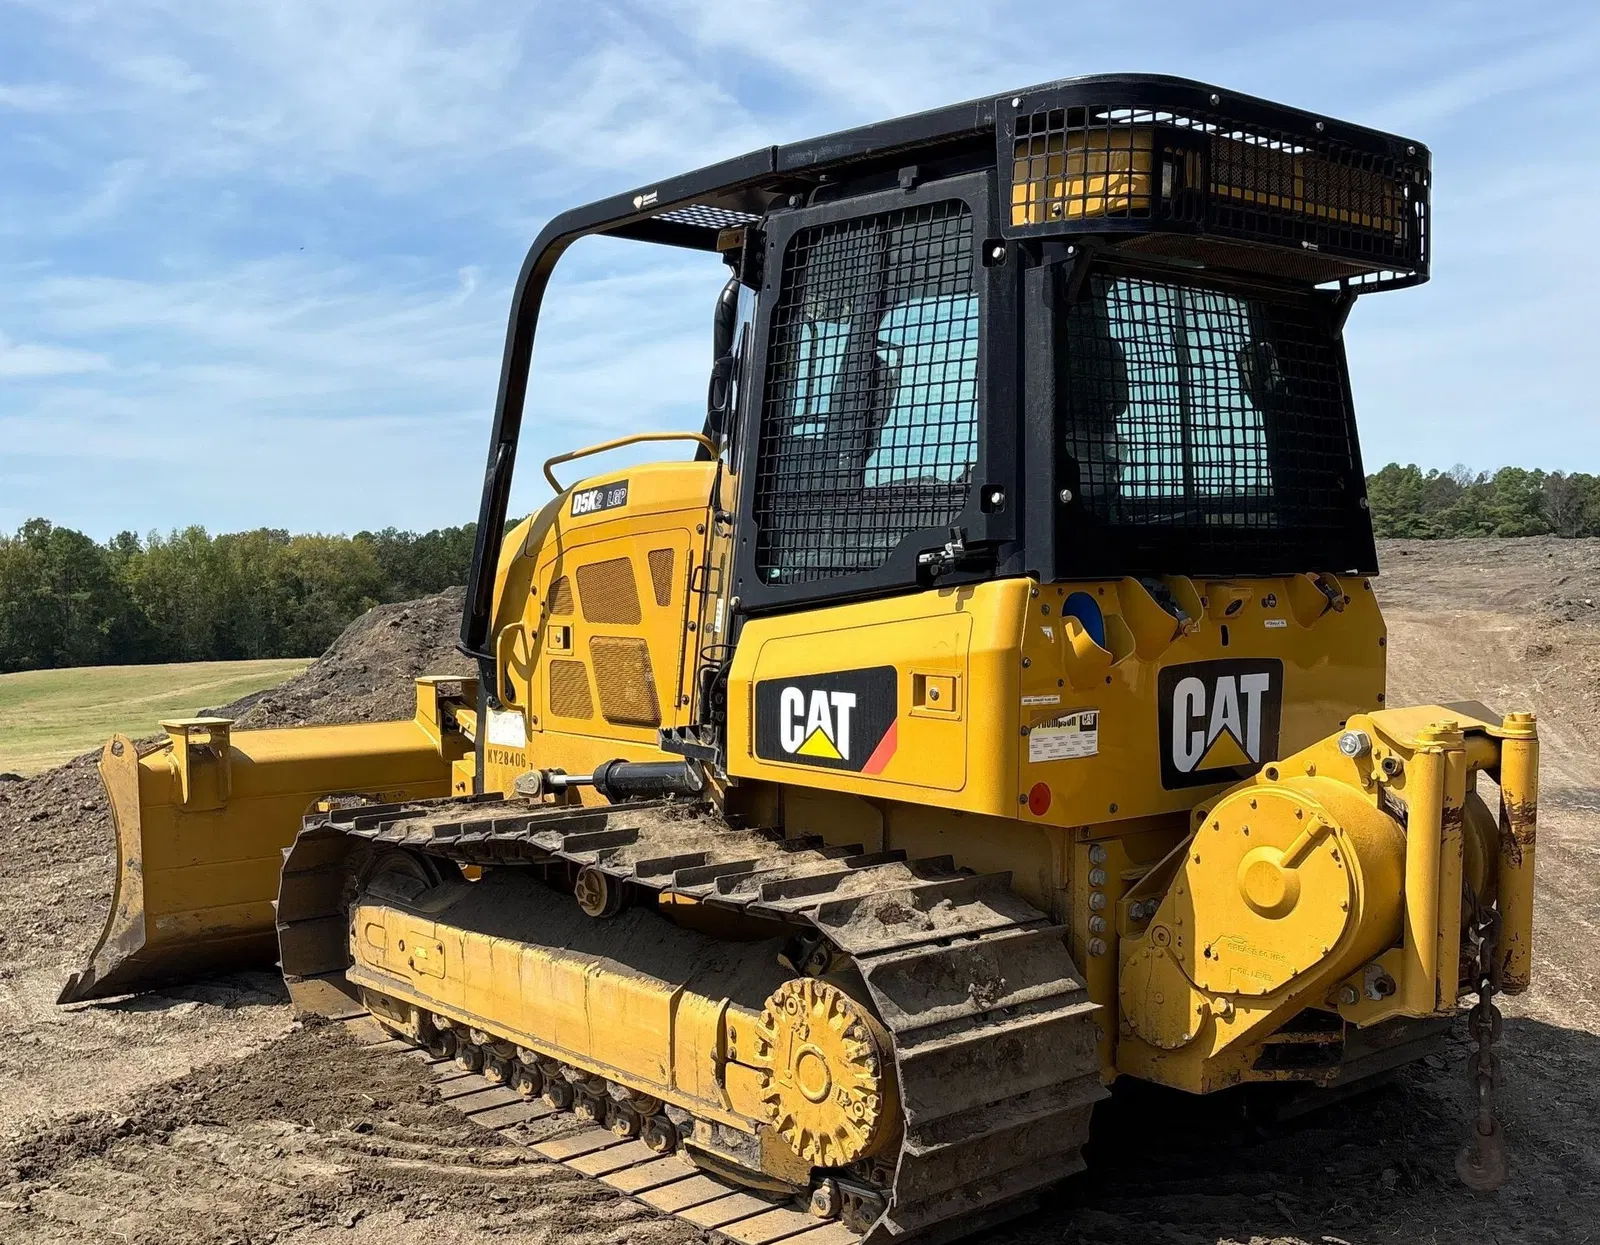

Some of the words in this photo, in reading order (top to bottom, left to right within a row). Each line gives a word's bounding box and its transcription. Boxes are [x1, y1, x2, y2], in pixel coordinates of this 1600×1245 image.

[572, 489, 604, 515] D5K2
[606, 487, 627, 507] LGP
[780, 686, 857, 761] CAT
[1081, 713, 1096, 726] CAT
[1172, 672, 1270, 773] CAT
[487, 749, 526, 768] KY28406
